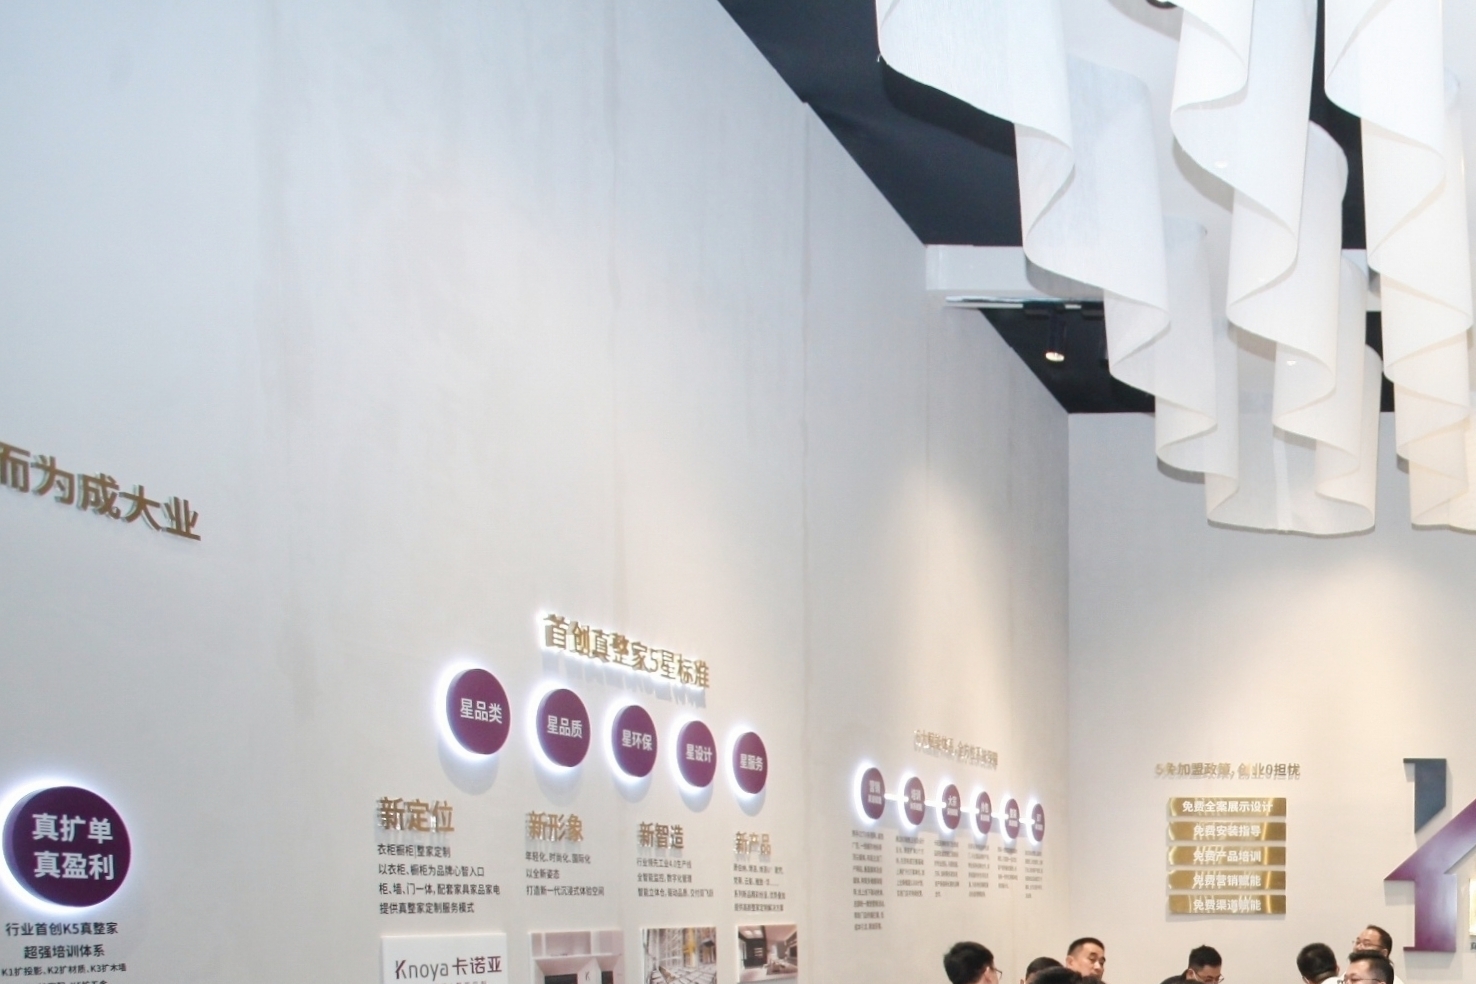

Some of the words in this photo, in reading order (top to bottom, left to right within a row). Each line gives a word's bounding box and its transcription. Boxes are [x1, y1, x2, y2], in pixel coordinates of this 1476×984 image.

[0, 441, 201, 541] 而为成大业
[543, 613, 710, 688] 首创真整家5星标准
[460, 697, 503, 724] 星品类
[547, 714, 583, 738] 星品质
[622, 729, 653, 751] 星环保
[685, 743, 713, 763] 星设计
[739, 753, 764, 772] 星服务
[377, 796, 455, 833] 新定位
[1182, 800, 1273, 813] 免费全案展示设计
[32, 812, 114, 845] 真扩单
[525, 810, 584, 842] 新形象
[637, 821, 684, 849] 新智造
[1194, 825, 1261, 837] 免费安装指导
[33, 850, 115, 881] 真盈利
[1193, 850, 1261, 863] 免费产品培训
[6, 922, 119, 937] 行业首创K5真整家
[24, 944, 106, 959] 超强培训体系
[395, 960, 449, 982] Knoya
[452, 956, 503, 976] 卡诺亚
